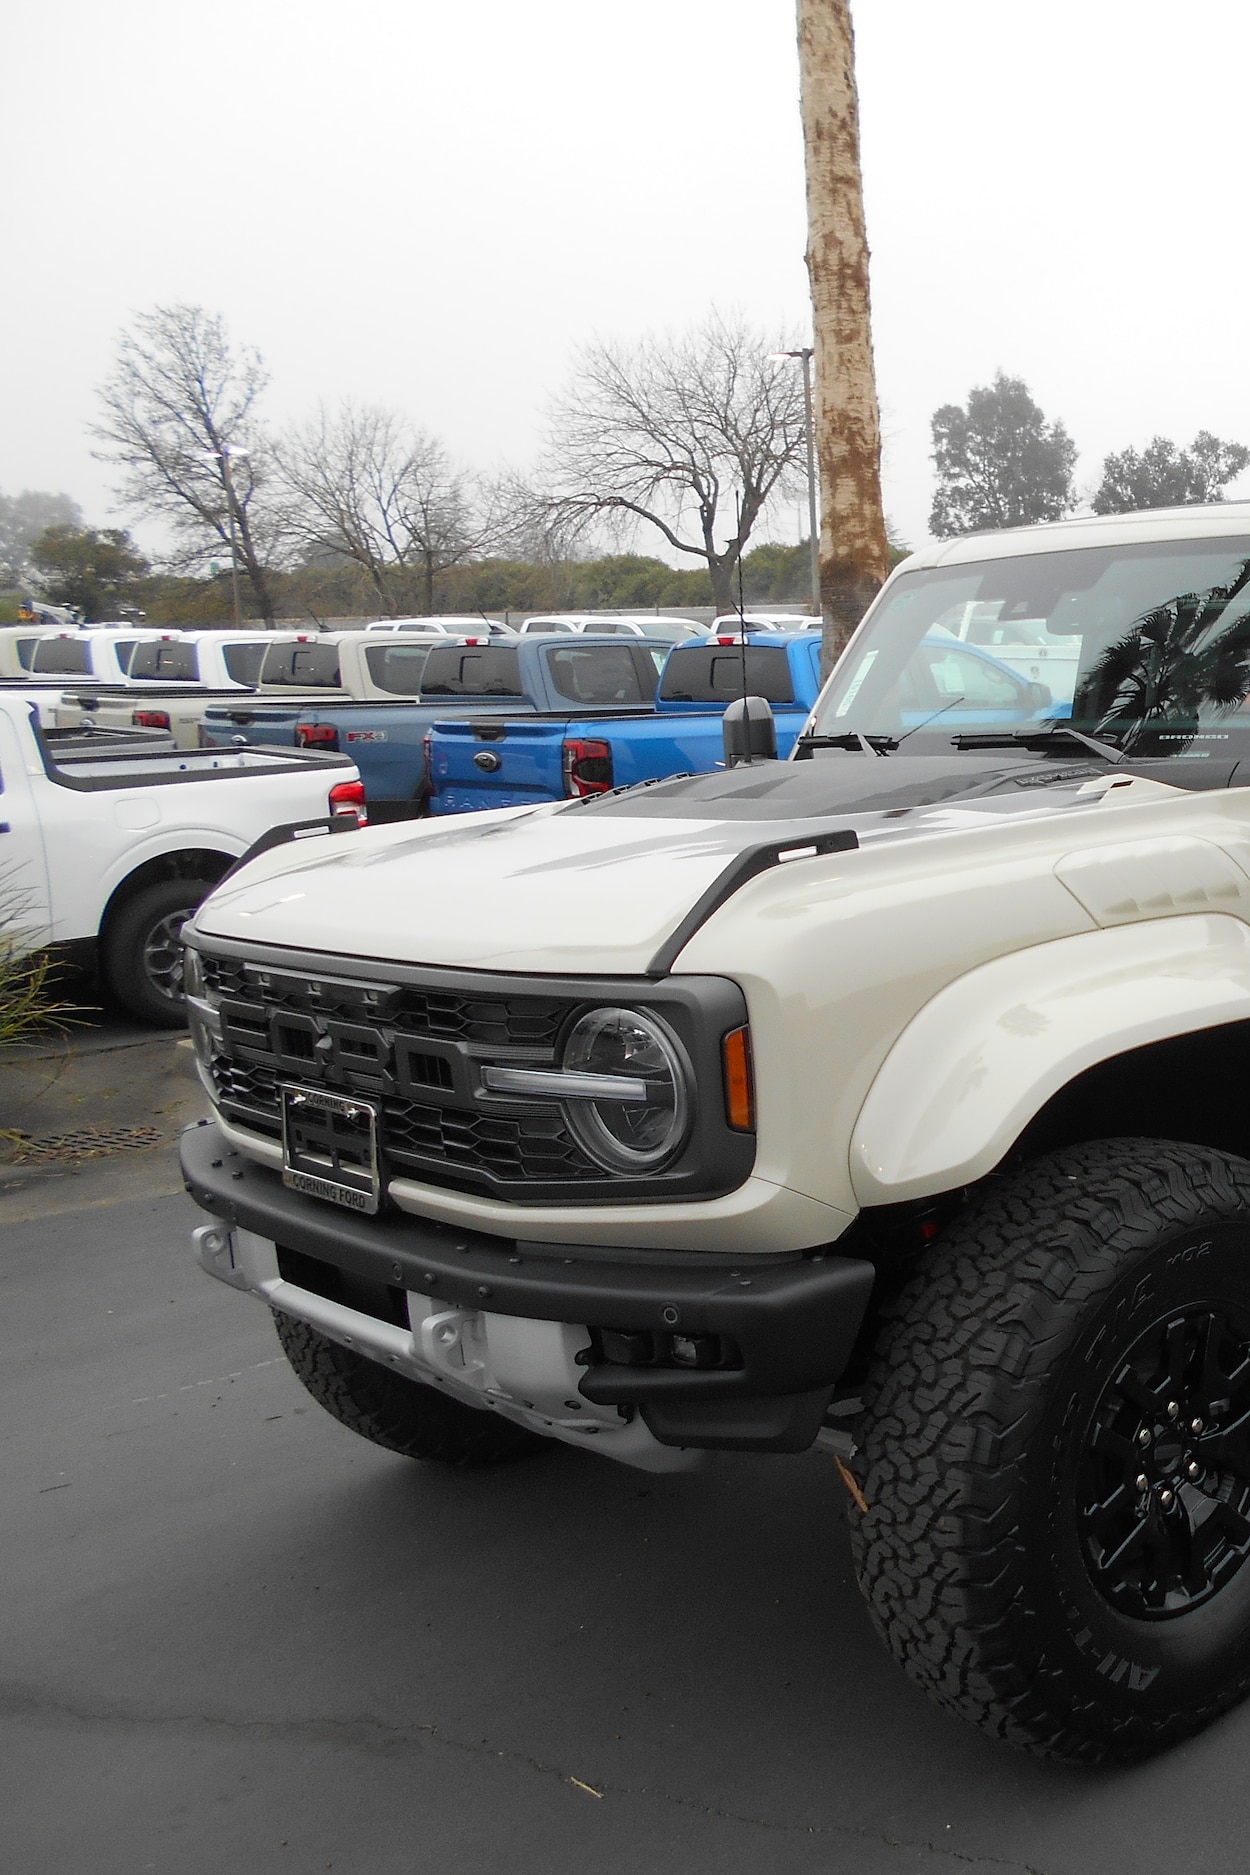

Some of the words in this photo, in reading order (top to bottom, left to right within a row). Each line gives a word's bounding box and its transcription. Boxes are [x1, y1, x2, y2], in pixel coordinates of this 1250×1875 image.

[219, 997, 470, 1109] FORD
[292, 1174, 338, 1199] CORNING
[339, 1188, 366, 1209] FORD
